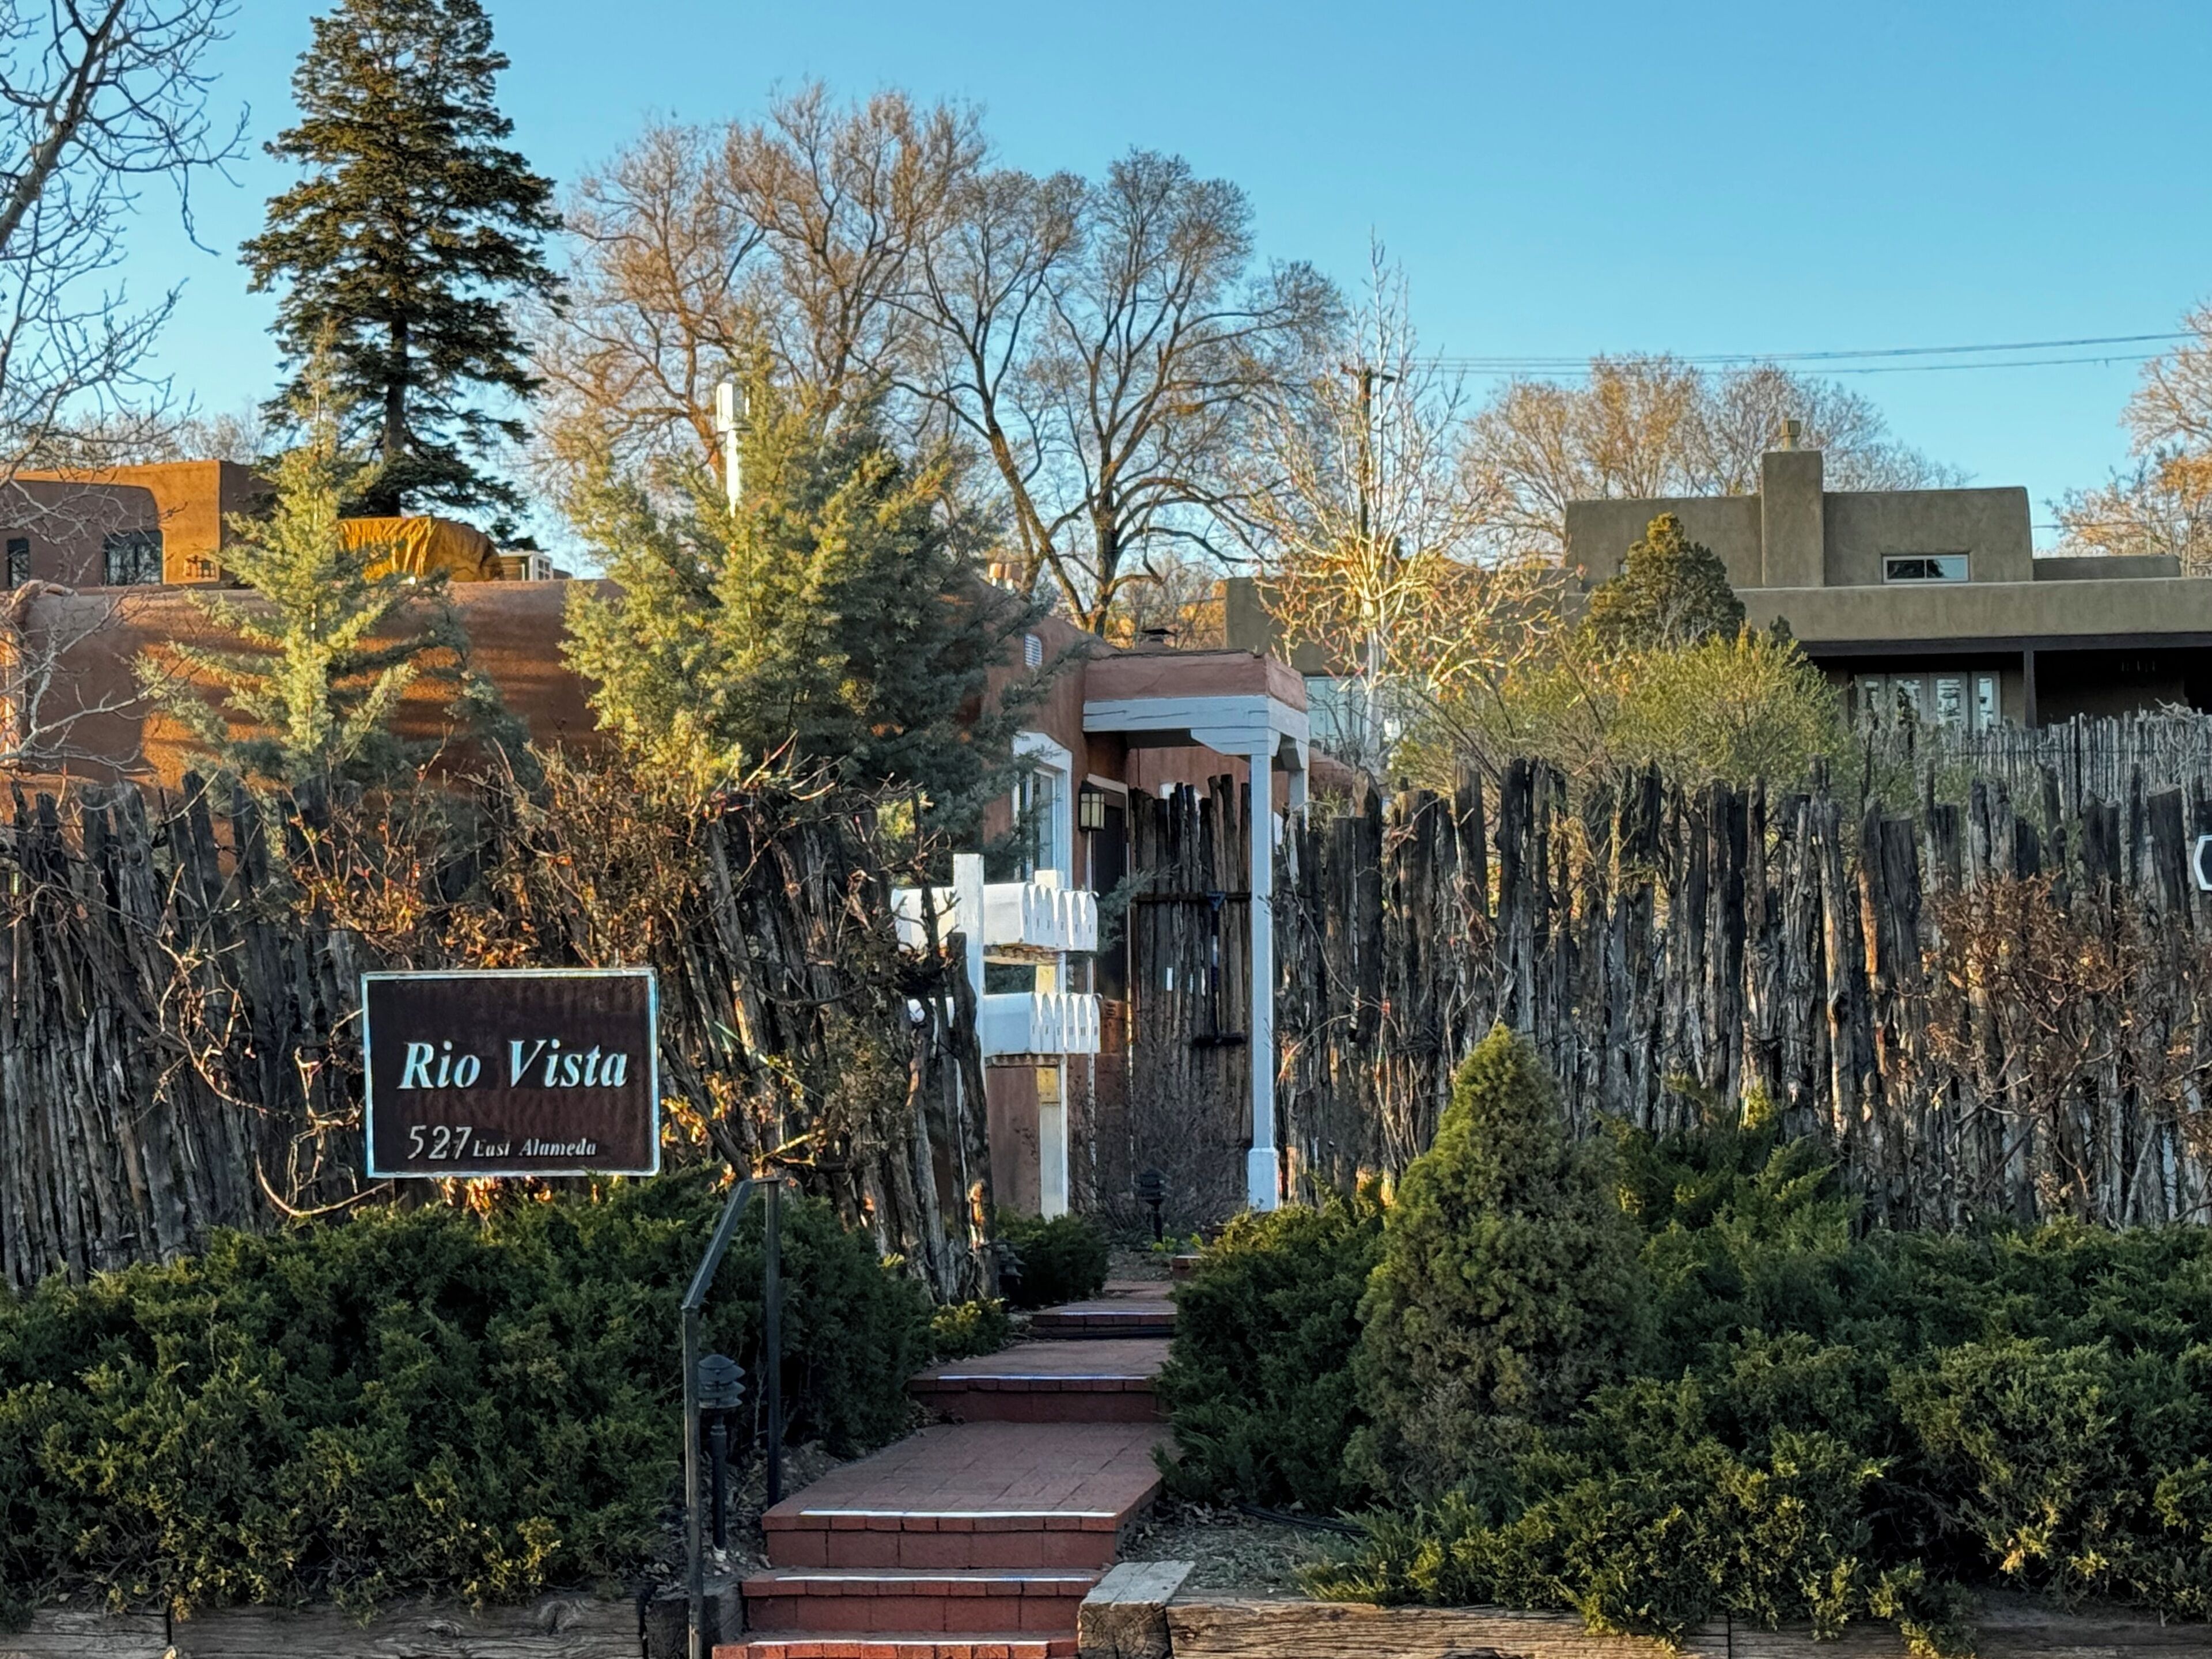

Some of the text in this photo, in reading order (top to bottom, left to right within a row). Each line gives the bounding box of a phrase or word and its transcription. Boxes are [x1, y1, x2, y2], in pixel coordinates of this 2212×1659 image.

[397, 1039, 628, 1089] Rio Vista
[407, 1124, 473, 1160] 527
[518, 1138, 597, 1157] Alameda
